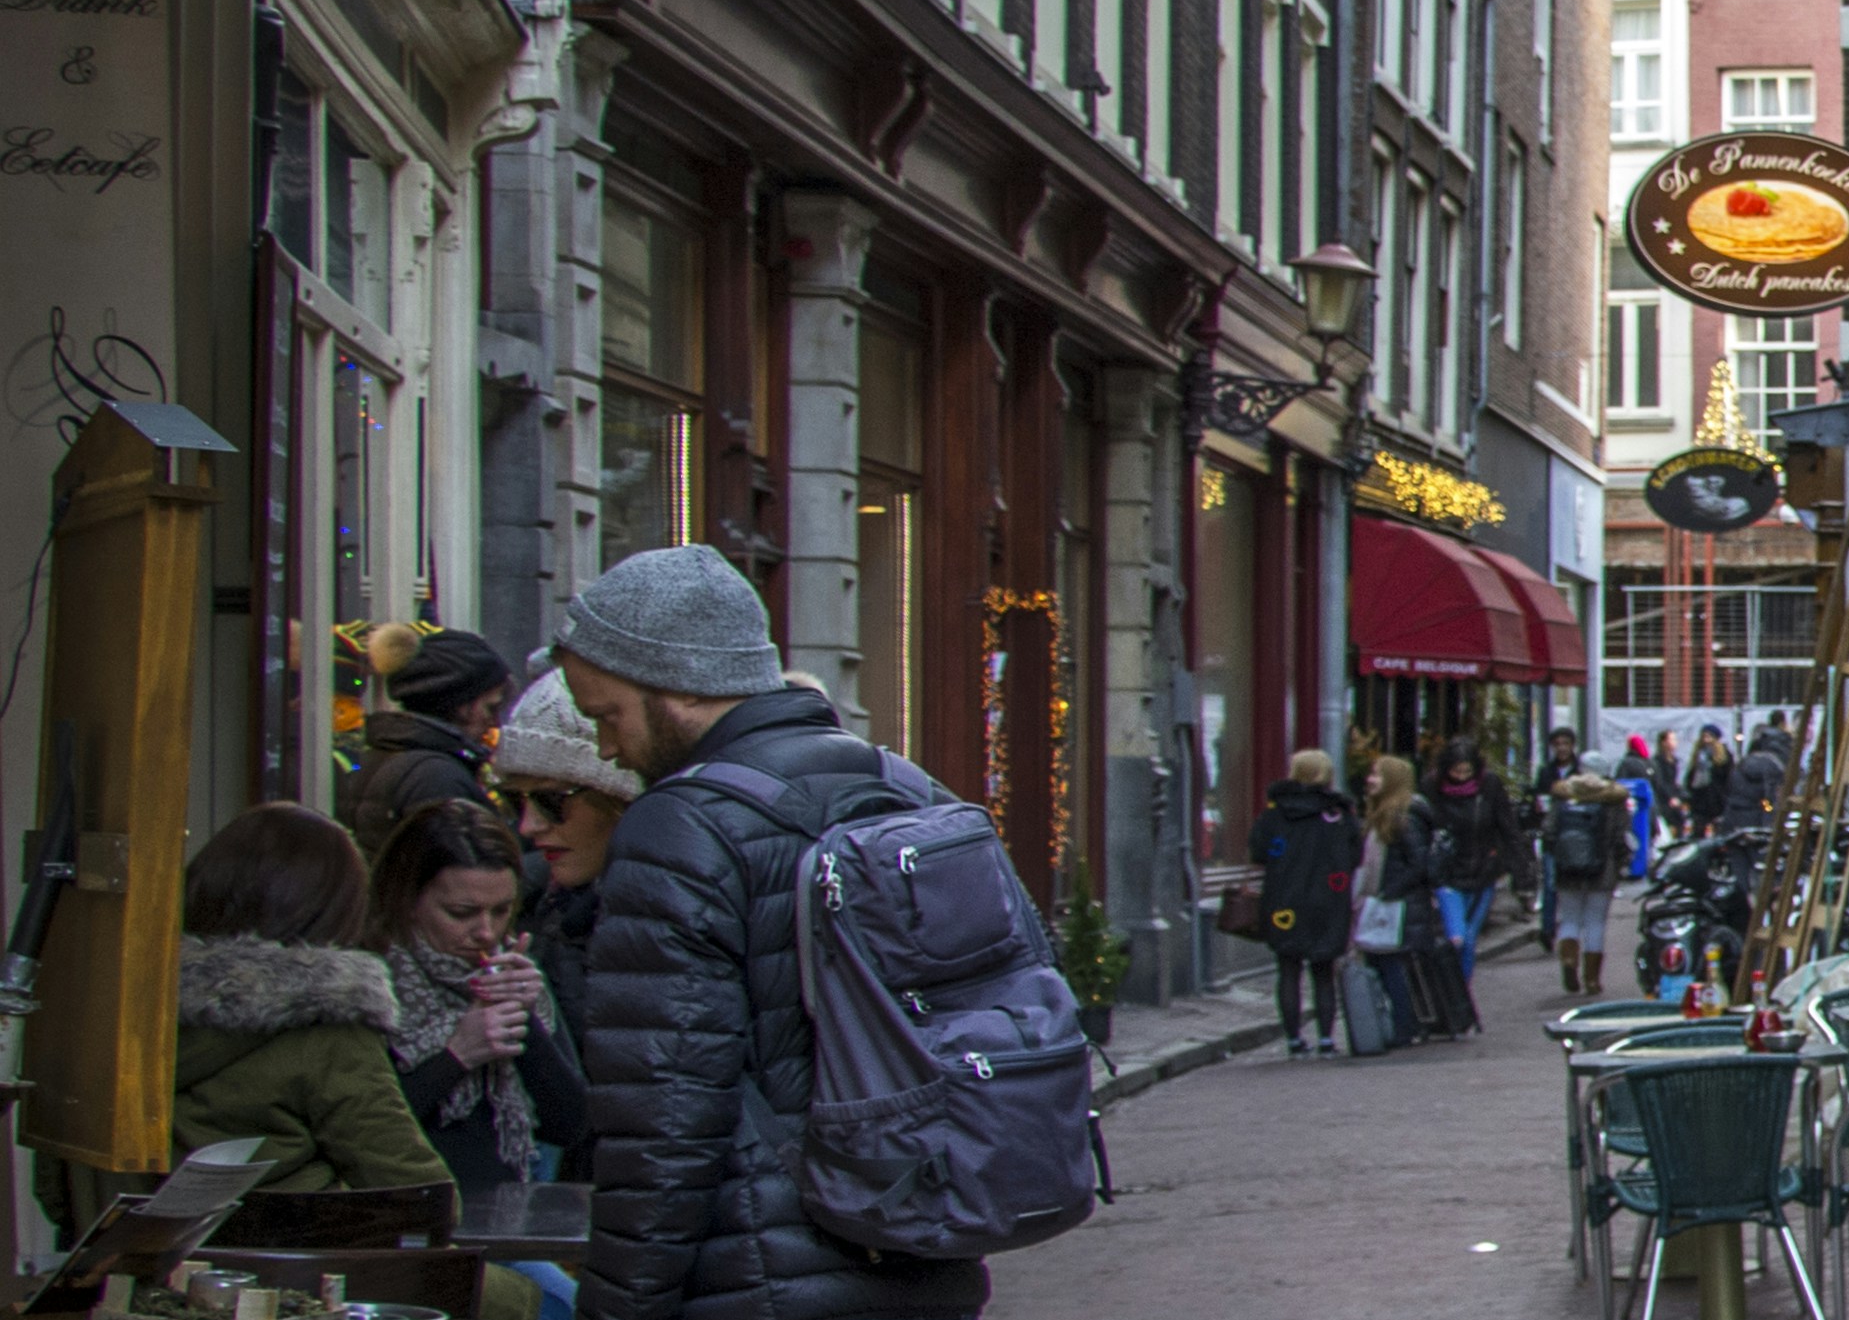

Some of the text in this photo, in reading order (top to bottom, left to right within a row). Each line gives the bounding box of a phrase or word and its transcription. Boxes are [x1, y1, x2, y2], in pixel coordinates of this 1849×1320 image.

[60, 45, 95, 85] &
[1657, 154, 1701, 200] De
[1690, 262, 1768, 290] Dutch
